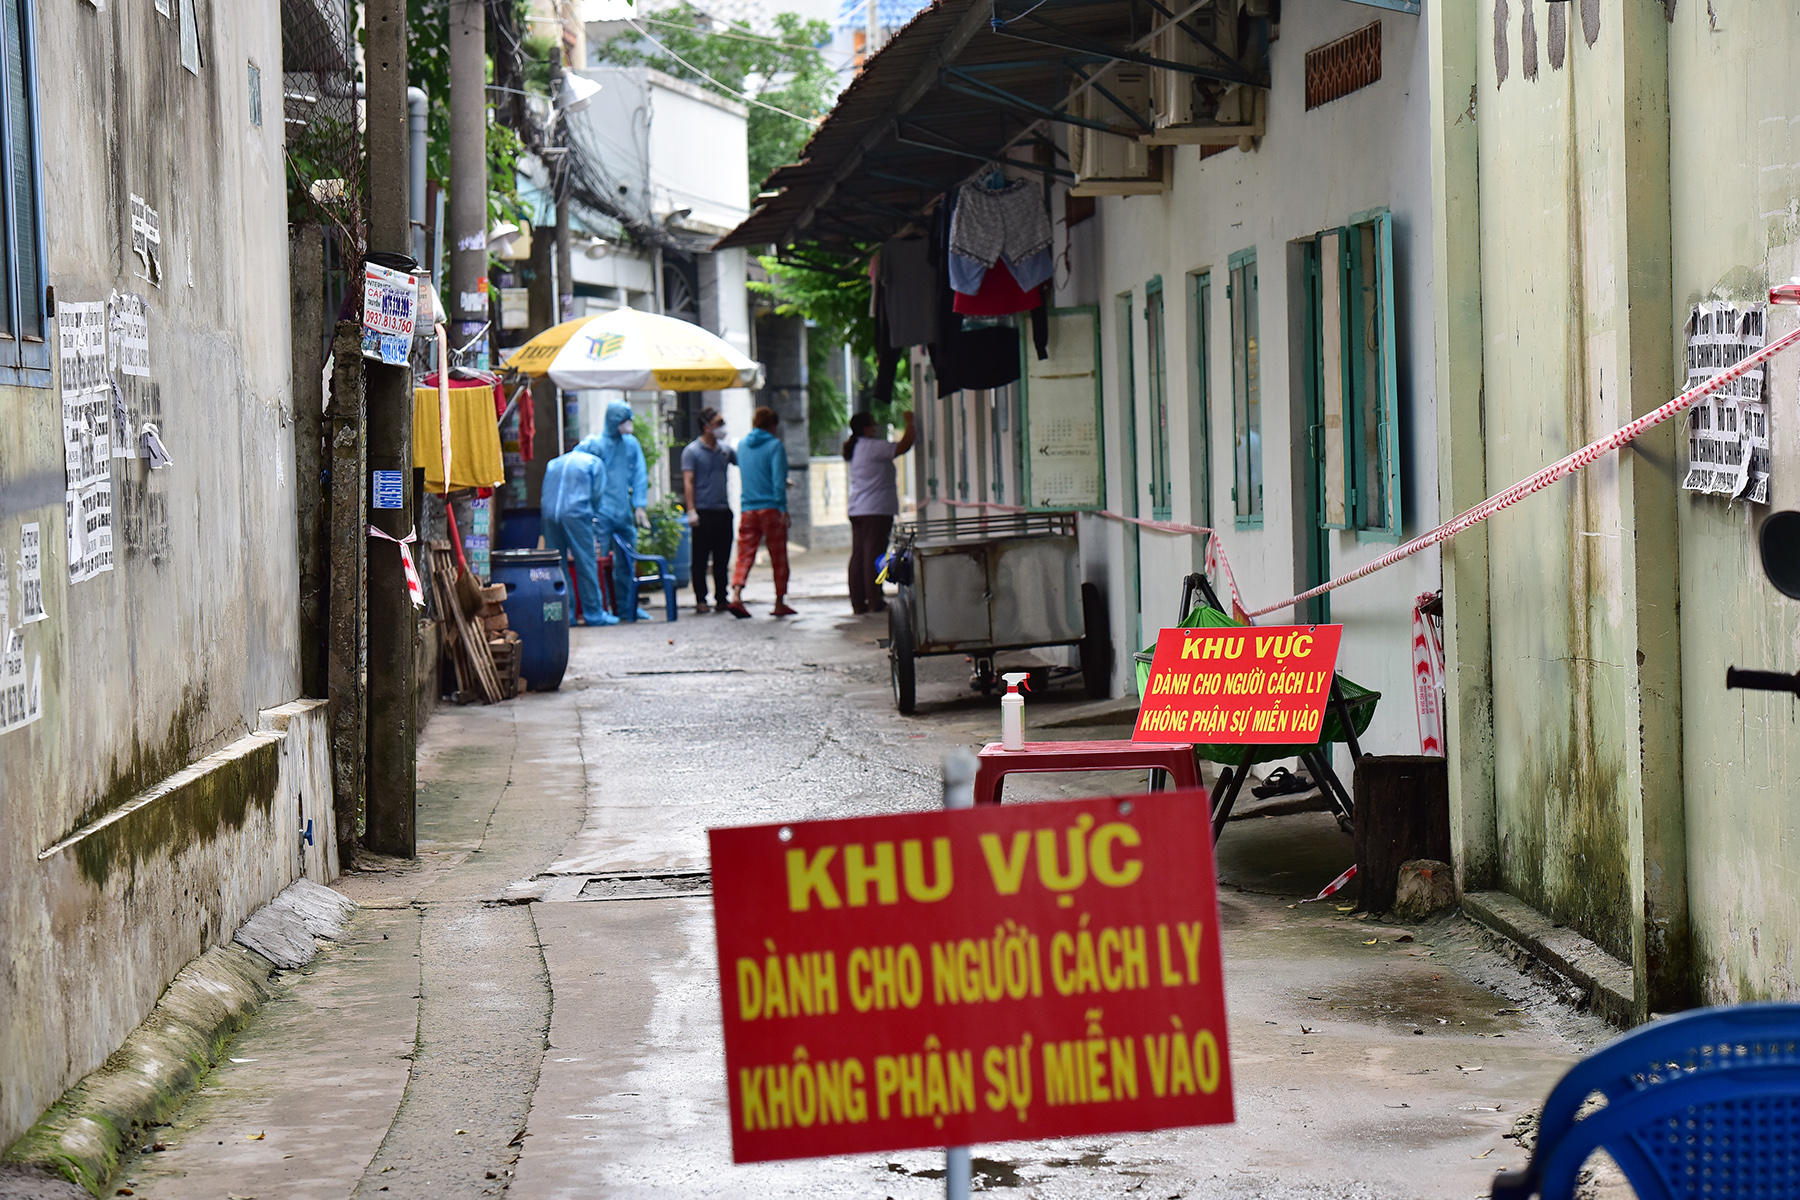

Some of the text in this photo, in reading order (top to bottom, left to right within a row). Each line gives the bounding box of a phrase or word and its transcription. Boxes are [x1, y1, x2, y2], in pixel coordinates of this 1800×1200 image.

[365, 310, 412, 333] 0937.813.760
[1181, 631, 1313, 664] KHU VỰC
[1151, 666, 1327, 695] DÀNH CHO NGƯỜI CÁCH LY
[1140, 699, 1319, 736] KHÔNG PHẬN SỰ MIỄN VÀO
[785, 813, 1144, 912] KHU VỰC
[736, 912, 1203, 1021] DÀNH CHO NGƯỜI CÁCH LY
[740, 1008, 1221, 1132] KHÔNG PHẬN SỰ MIỄN VÀO
